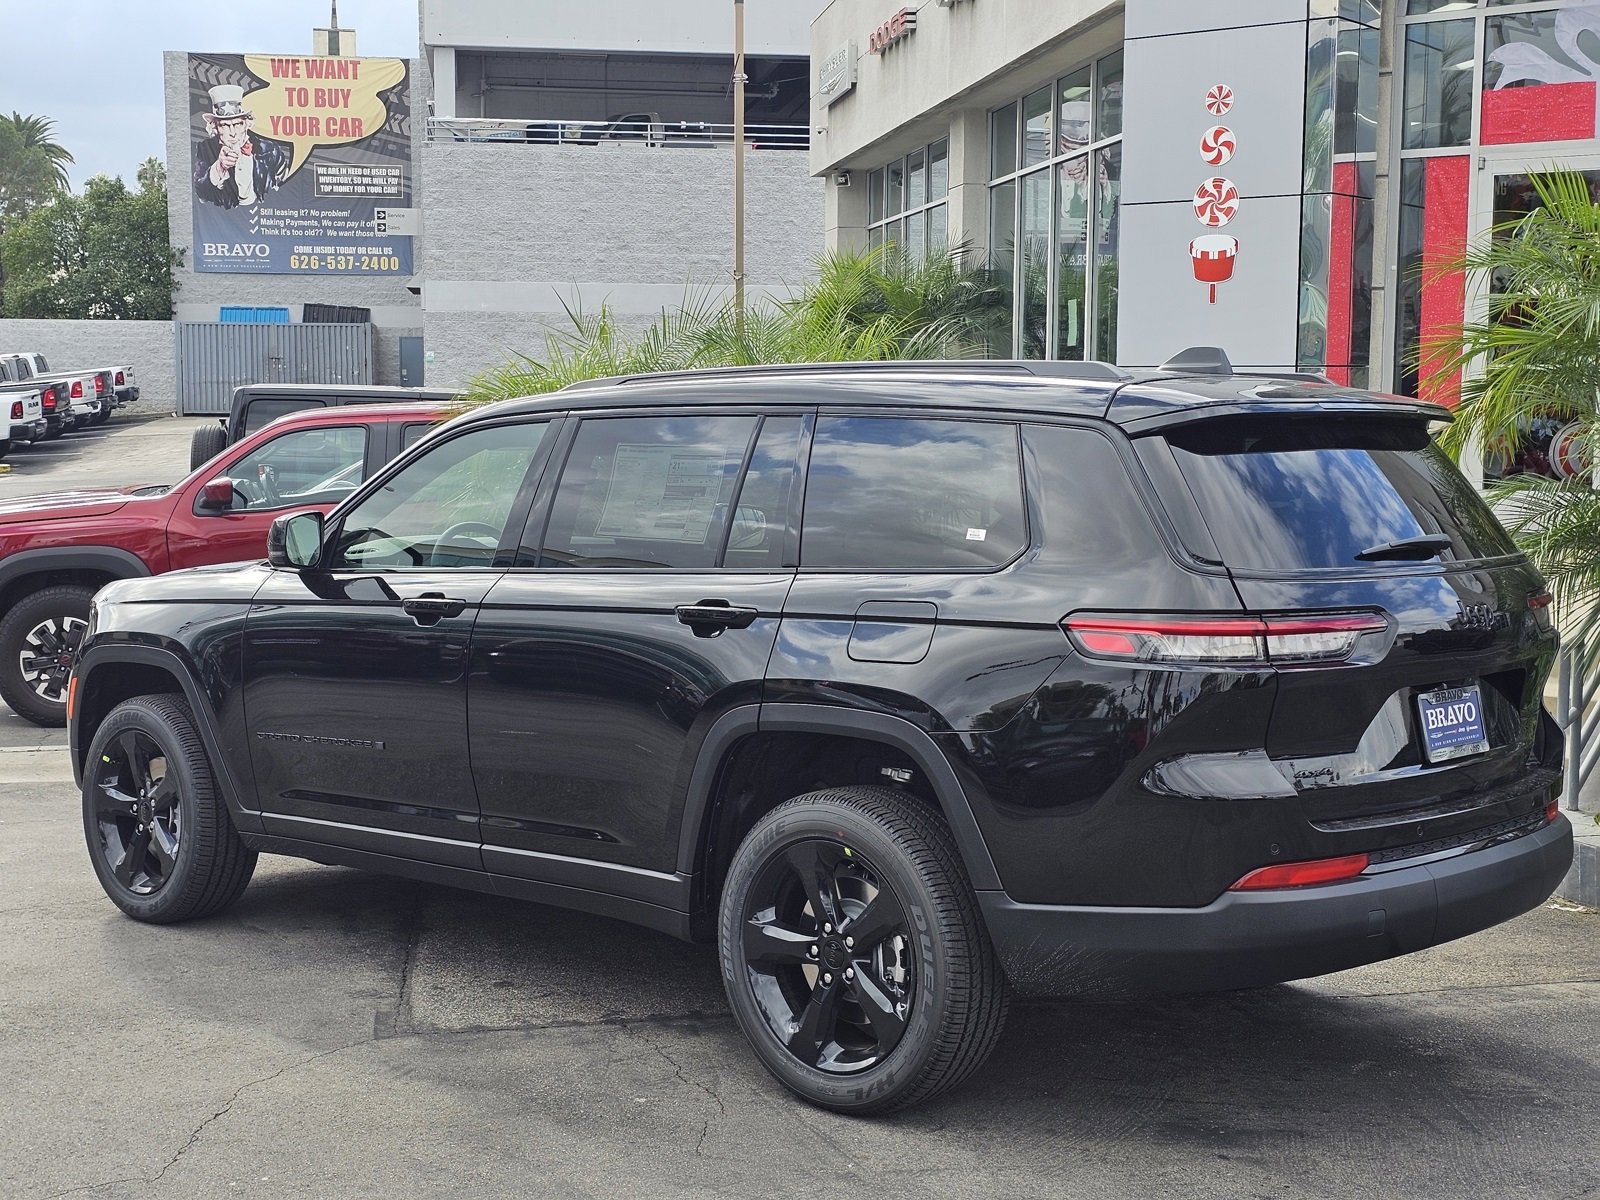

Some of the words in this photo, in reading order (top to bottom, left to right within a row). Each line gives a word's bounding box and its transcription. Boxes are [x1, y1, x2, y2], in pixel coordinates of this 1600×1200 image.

[869, 7, 917, 55] DODGE
[270, 58, 300, 78] WE
[304, 59, 361, 80] WANT
[285, 87, 309, 107] TO
[314, 88, 352, 108] BUY
[270, 116, 320, 136] YOUR
[325, 117, 363, 137] CAR
[260, 208, 273, 216] Still
[274, 208, 298, 218] leasing
[320, 210, 350, 218] problem!
[260, 218, 284, 228] Making
[286, 218, 320, 228] Payments,
[346, 220, 359, 229] pay
[260, 228, 280, 236] Think
[202, 243, 270, 257] BRAVO
[290, 255, 399, 271] 626-537-2400
[1456, 600, 1494, 631] Jeep
[1435, 689, 1464, 703] BRAVO
[1426, 702, 1476, 730] BRAVO
